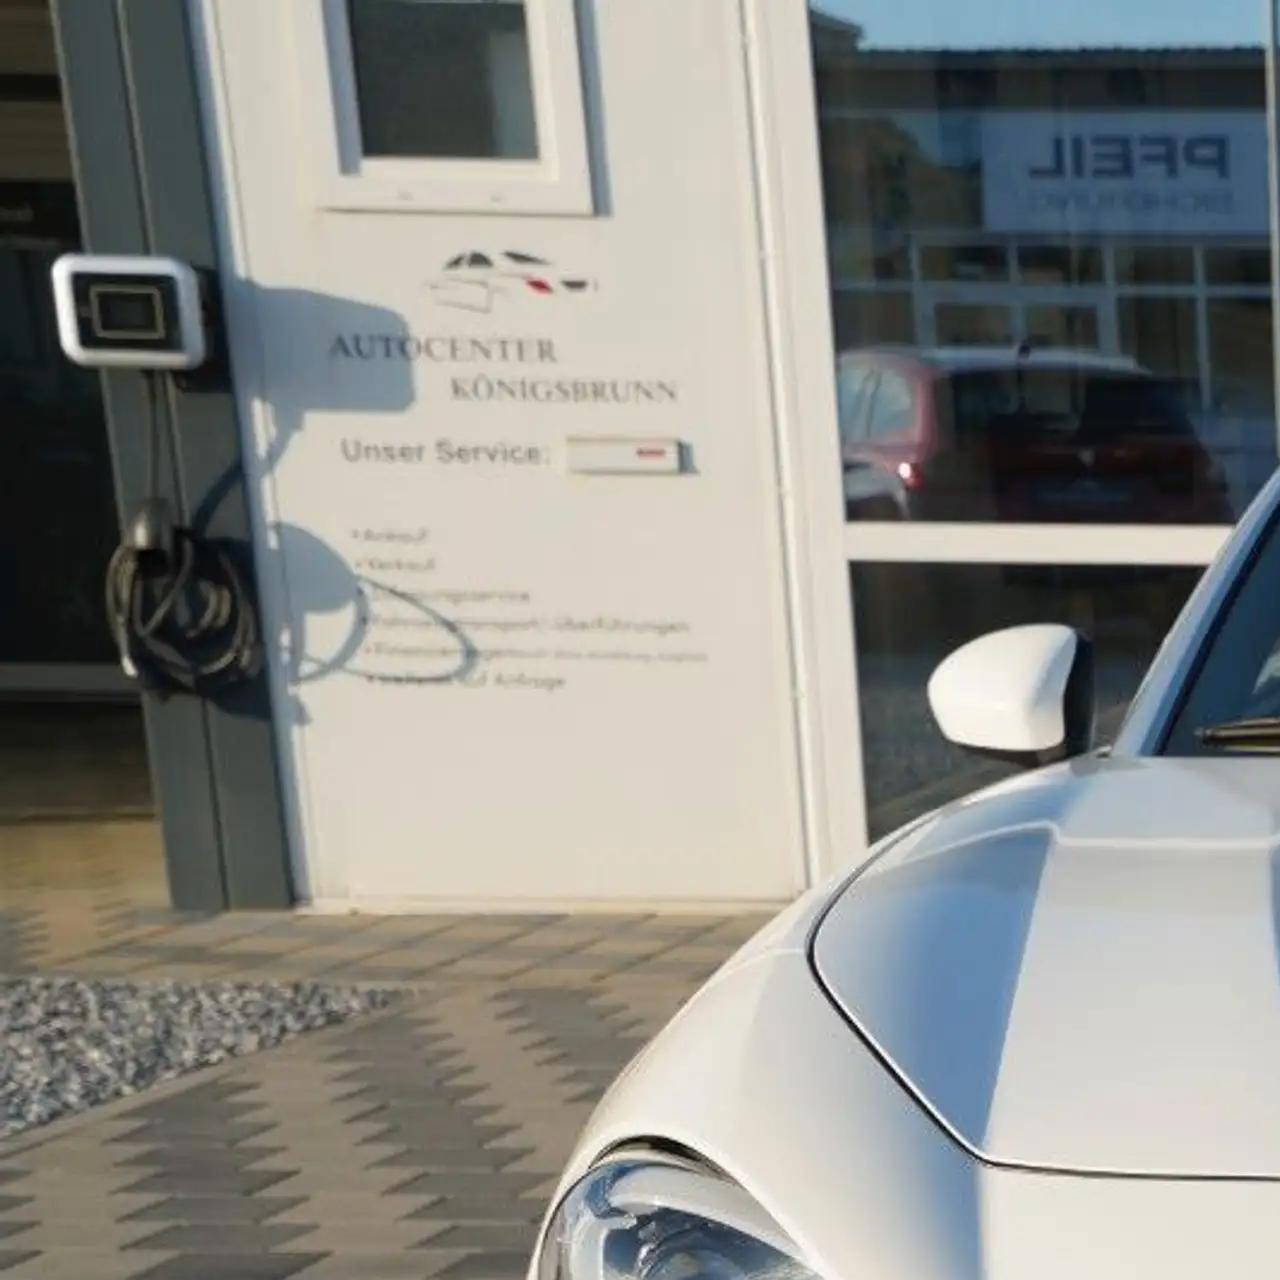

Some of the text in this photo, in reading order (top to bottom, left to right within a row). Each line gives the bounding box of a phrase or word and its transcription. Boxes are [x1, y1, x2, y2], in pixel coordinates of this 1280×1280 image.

[329, 334, 558, 364] AUTOCENTER
[450, 373, 679, 404] KÖNIGSBRUNN
[341, 438, 425, 464] Unser
